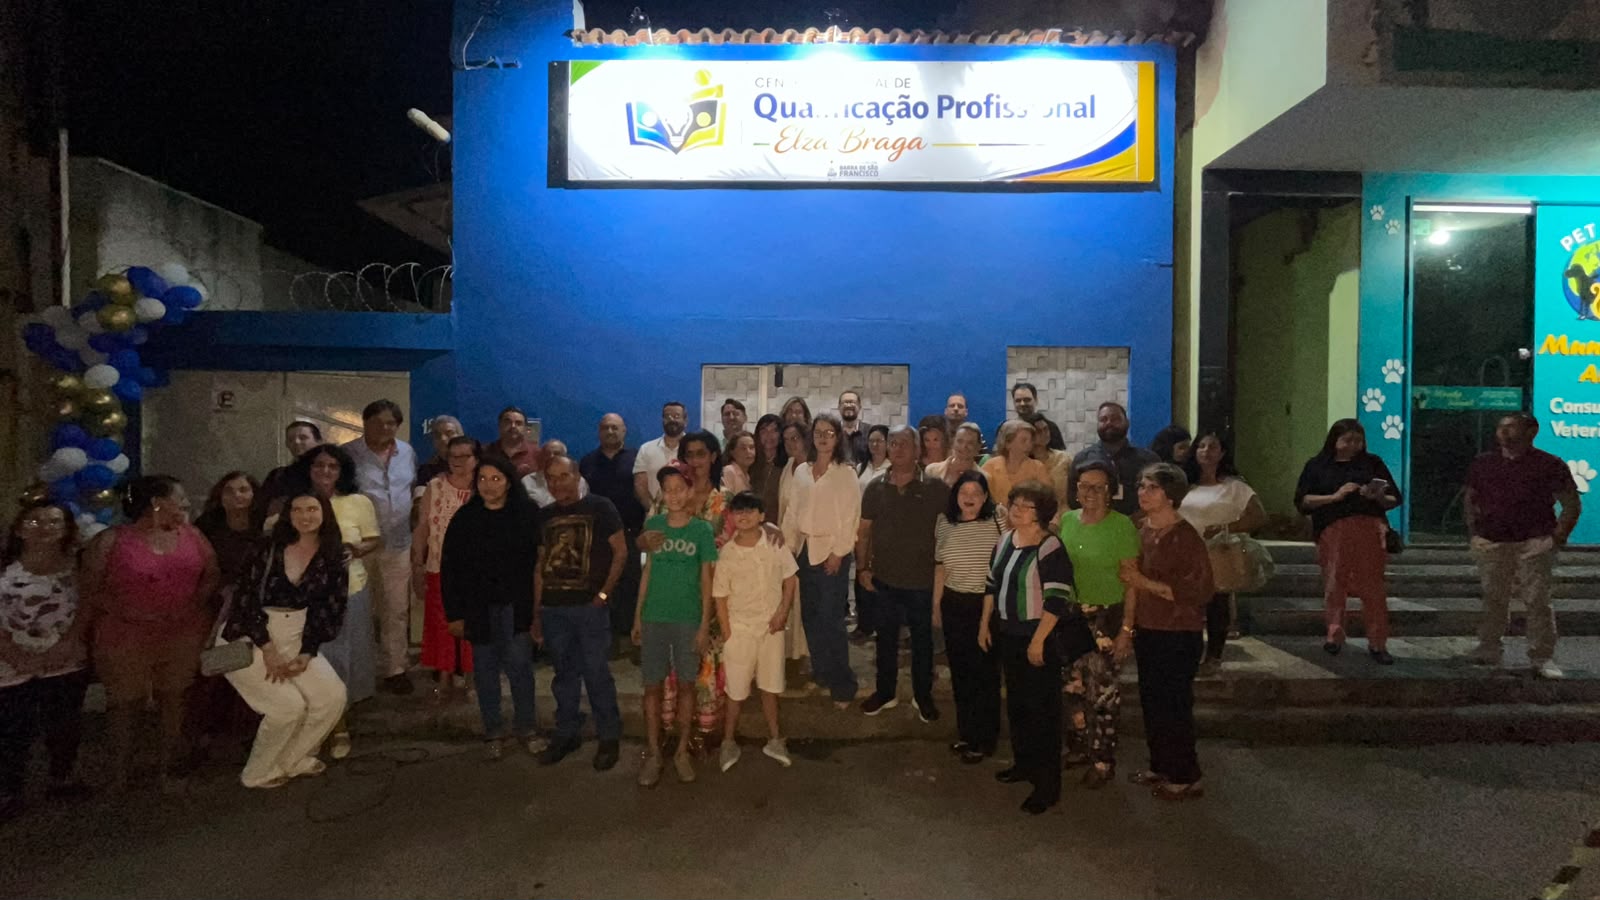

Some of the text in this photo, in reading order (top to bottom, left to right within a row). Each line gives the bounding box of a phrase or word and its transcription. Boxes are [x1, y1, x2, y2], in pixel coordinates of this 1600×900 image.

[895, 78, 911, 88] DE
[774, 125, 928, 162] Elza Braga
[1560, 223, 1596, 252] PET
[654, 538, 696, 556] OOD
